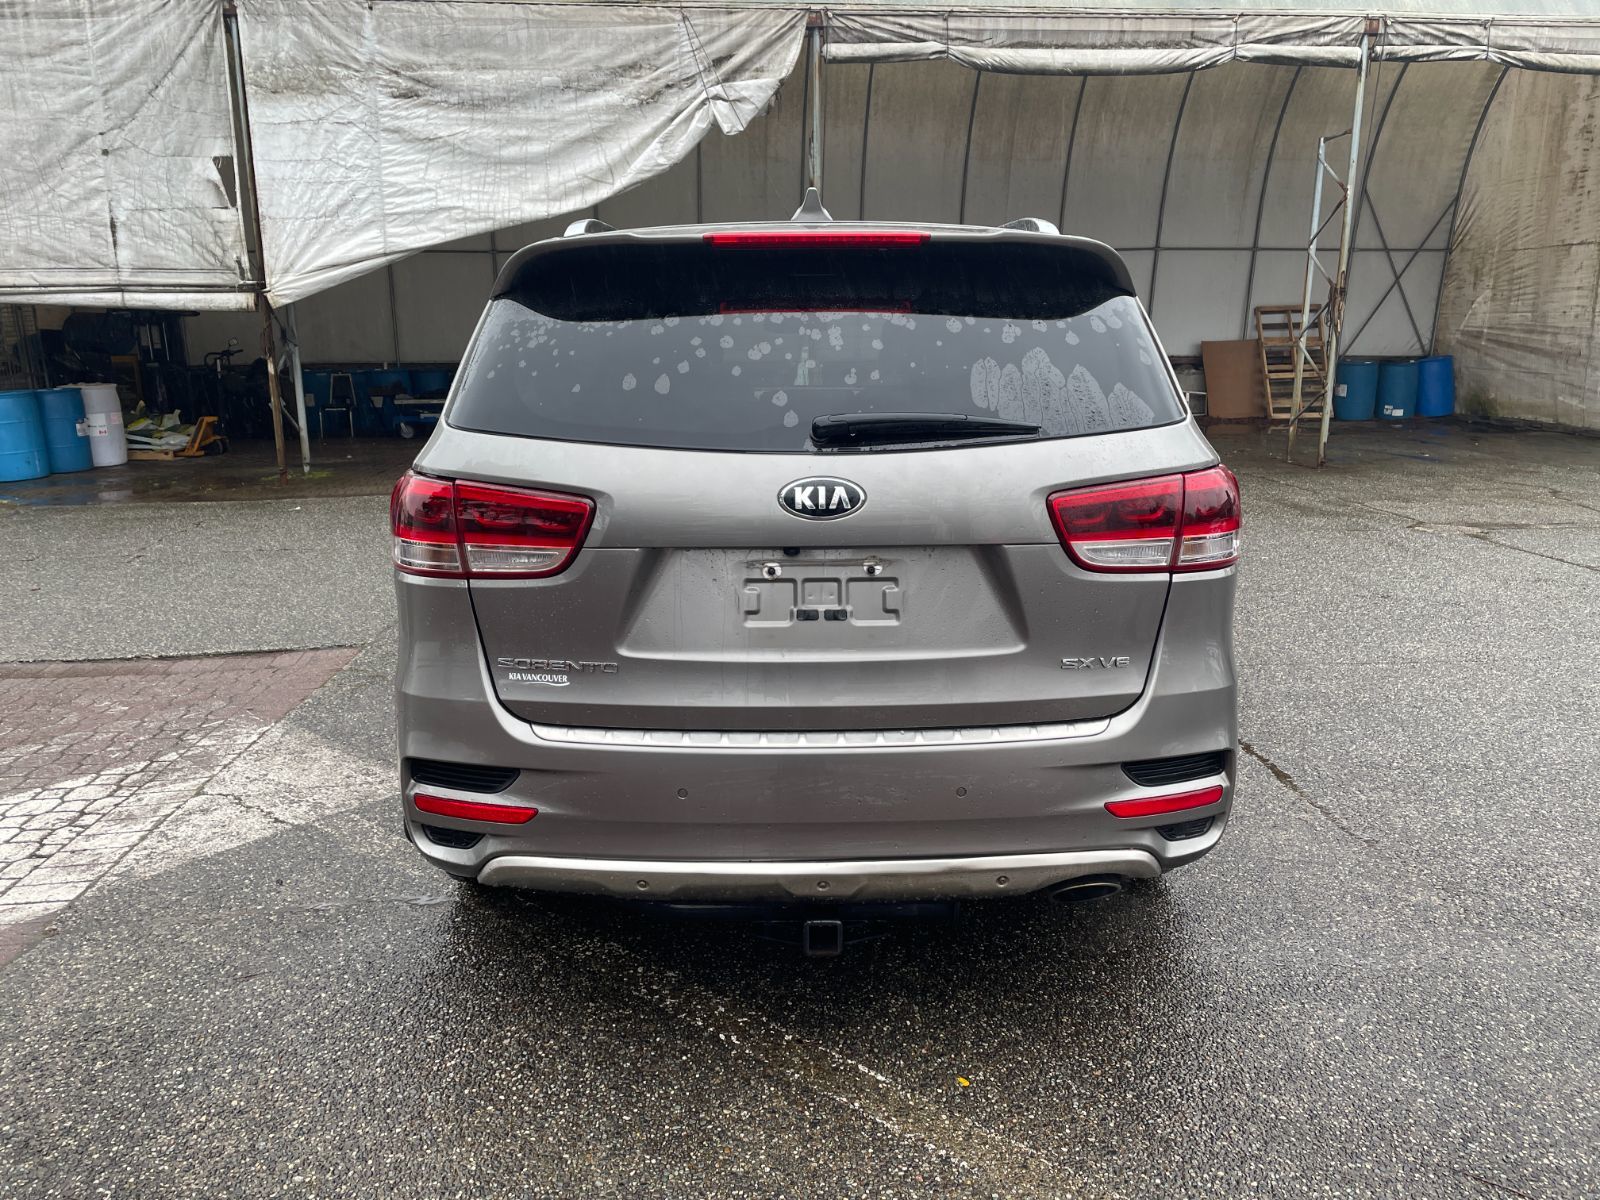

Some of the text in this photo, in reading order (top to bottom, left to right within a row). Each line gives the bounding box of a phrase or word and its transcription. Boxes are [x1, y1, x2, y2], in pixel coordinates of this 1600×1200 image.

[794, 486, 851, 509] KIA
[498, 657, 618, 673] SORENTO
[1061, 657, 1095, 670] SX
[508, 672, 568, 683] KIA VANCOUVER
